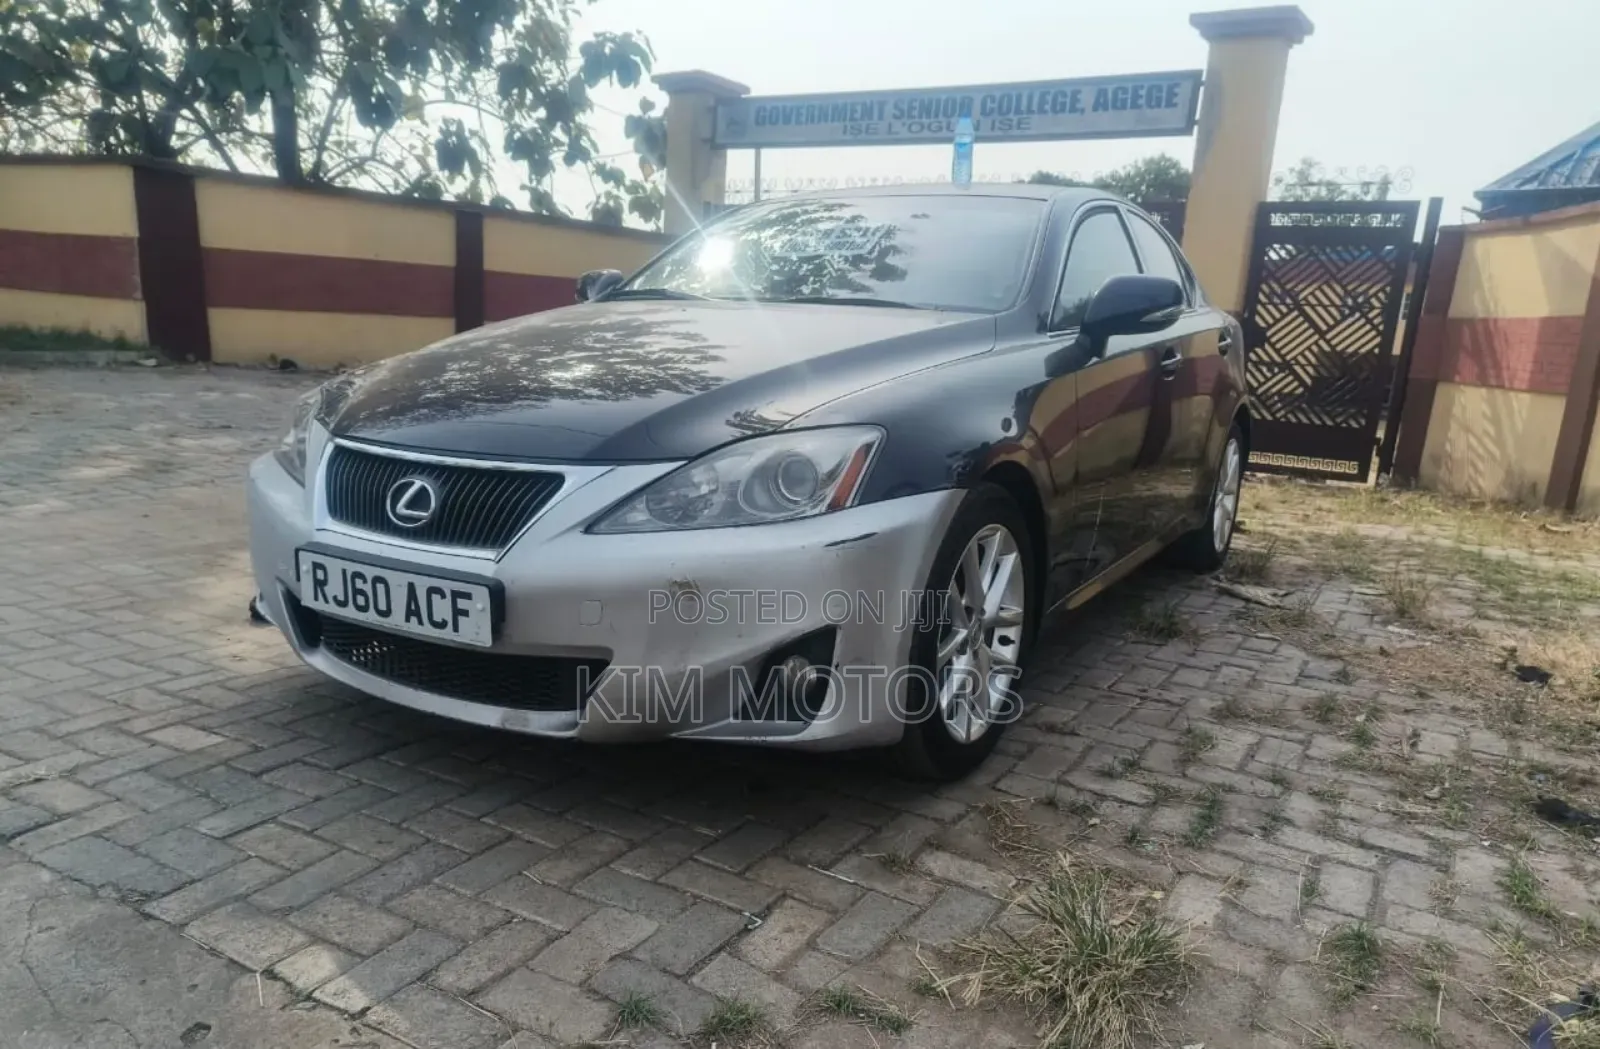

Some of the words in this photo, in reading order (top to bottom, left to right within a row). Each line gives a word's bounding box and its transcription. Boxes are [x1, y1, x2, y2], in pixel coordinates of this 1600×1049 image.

[754, 98, 887, 127] GOVERNMENT
[980, 88, 1086, 117] COLLEGE,
[1092, 82, 1182, 112] AGEGE
[311, 561, 392, 618] RJ60
[404, 581, 473, 633] ACF
